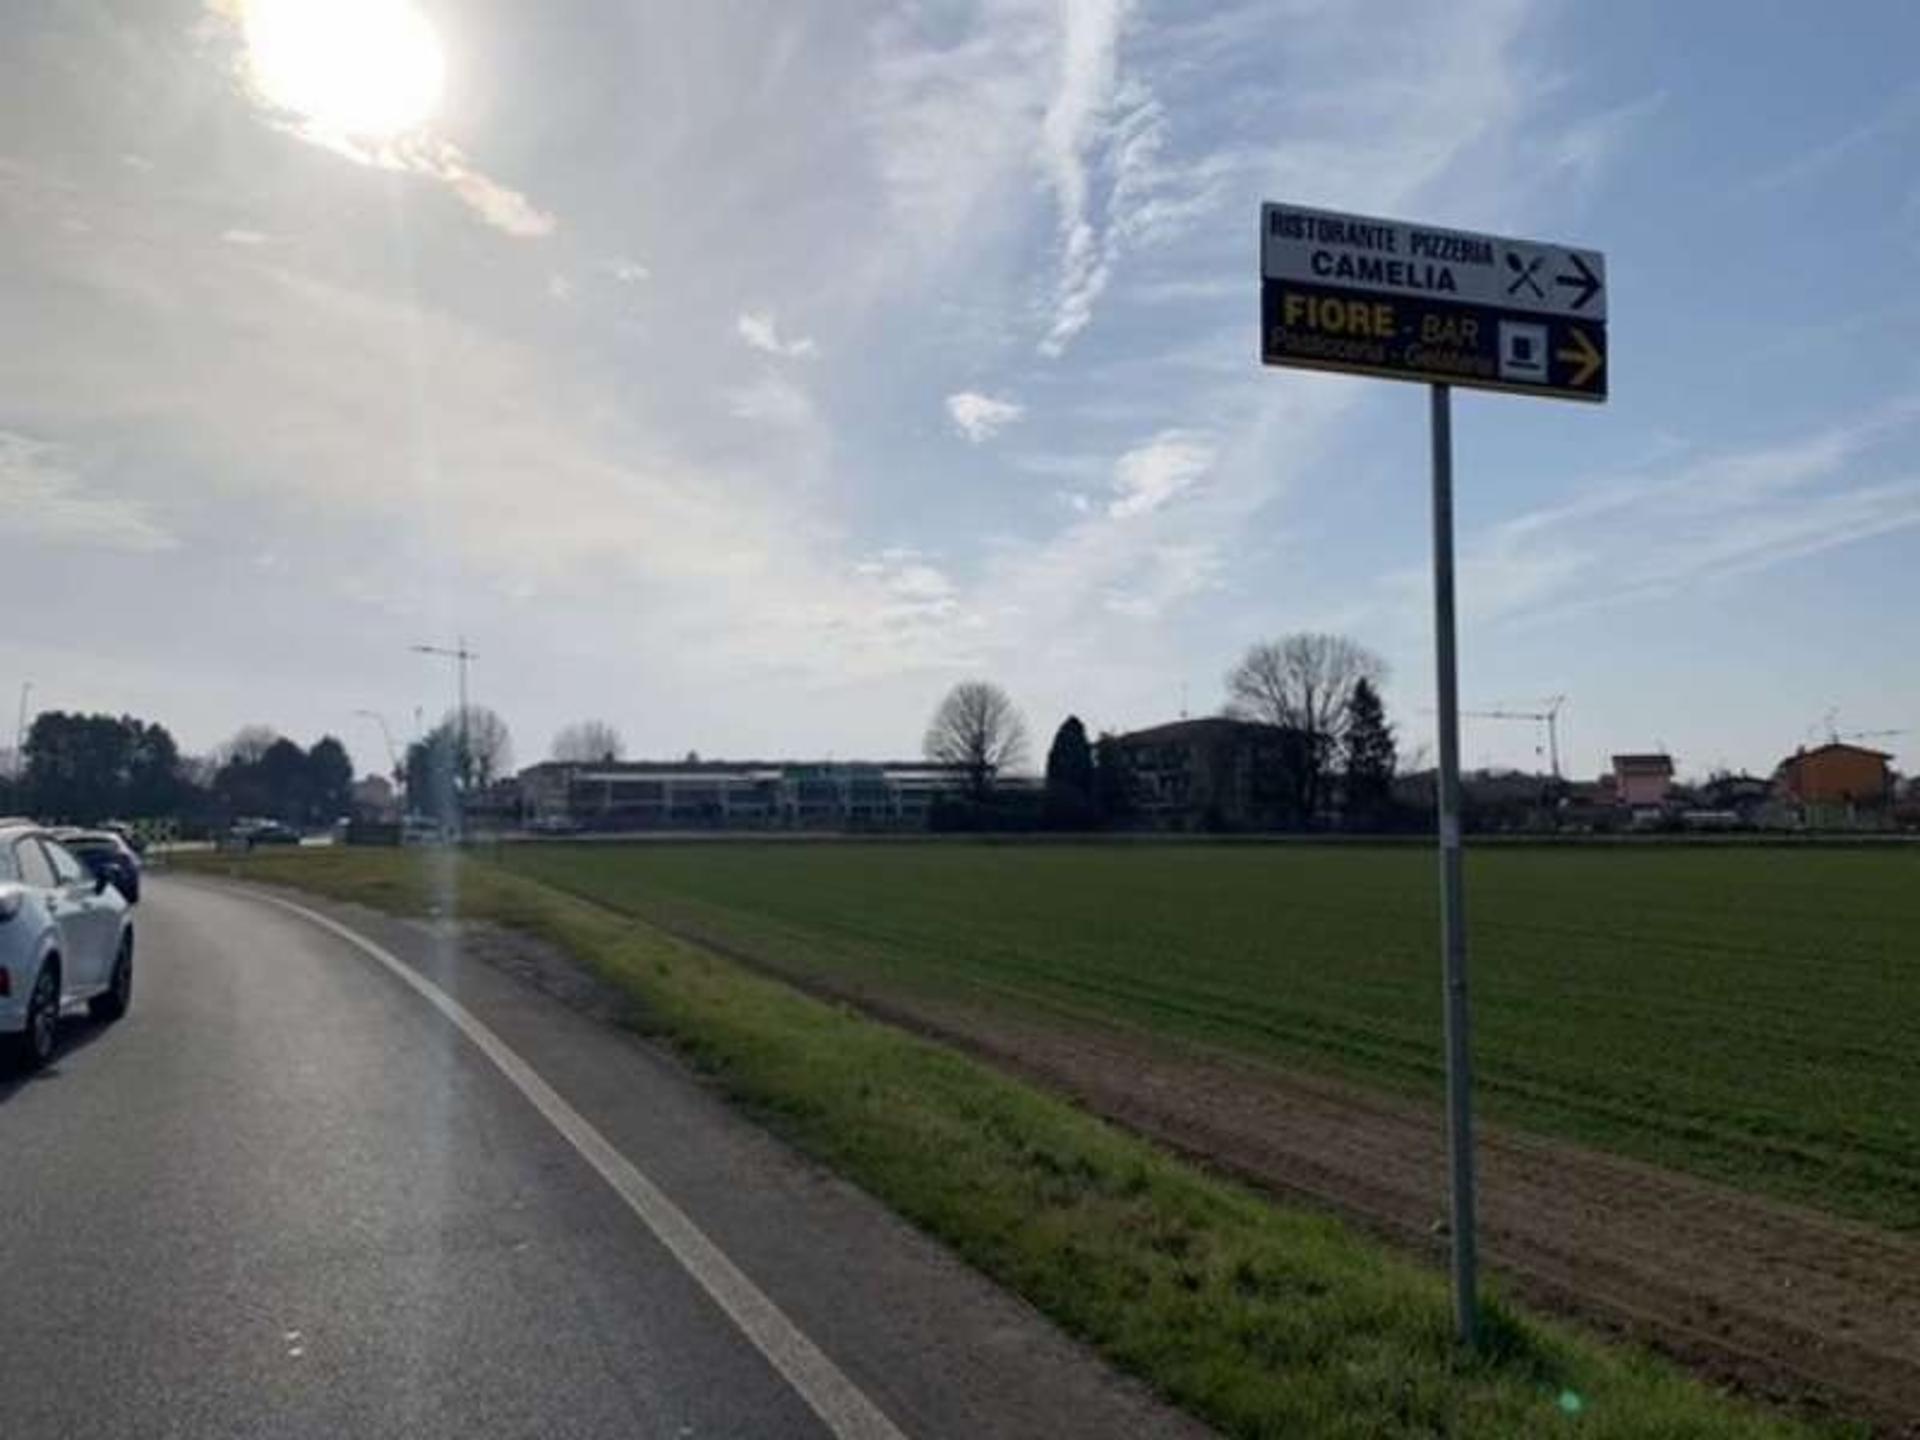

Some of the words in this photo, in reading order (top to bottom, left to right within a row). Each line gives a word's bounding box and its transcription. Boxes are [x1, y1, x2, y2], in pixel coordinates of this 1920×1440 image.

[1271, 211, 1395, 252] RISTORANTE
[1410, 232, 1495, 267] PIZZERIA
[1310, 250, 1457, 292] CAMELIA
[1284, 294, 1396, 337] FIORE
[1421, 314, 1479, 347] BAR
